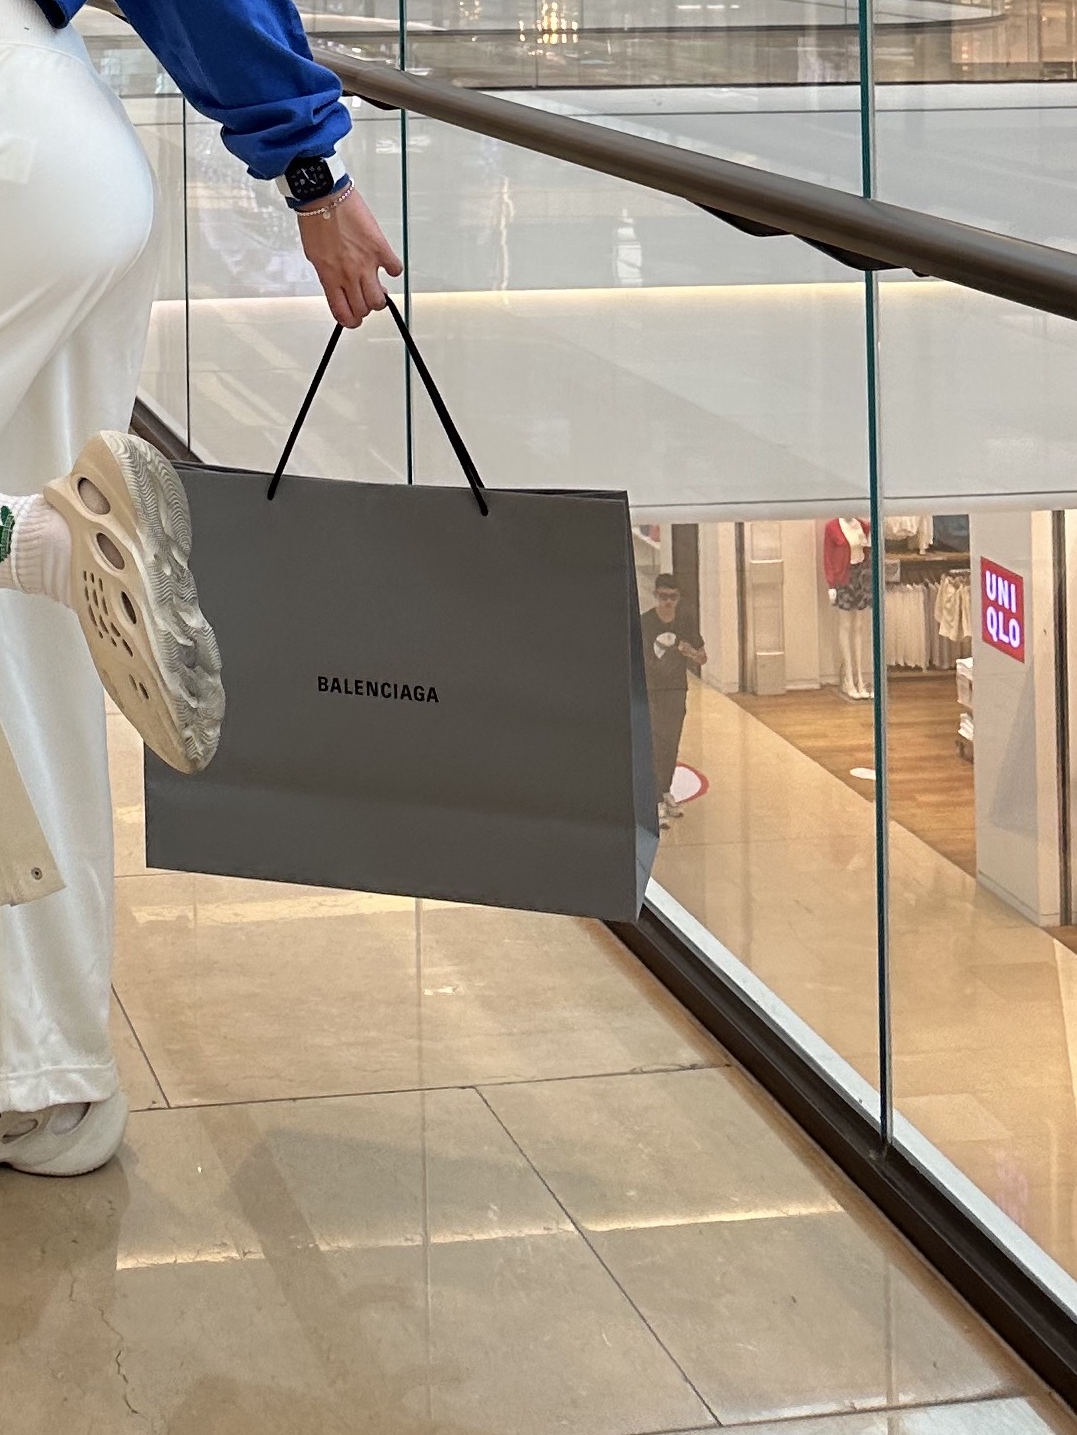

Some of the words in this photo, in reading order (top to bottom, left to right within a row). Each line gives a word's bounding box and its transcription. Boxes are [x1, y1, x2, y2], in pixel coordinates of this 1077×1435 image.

[985, 570, 1017, 614] UNI
[986, 606, 1021, 649] QLO
[317, 675, 440, 703] BALENCIAGA
